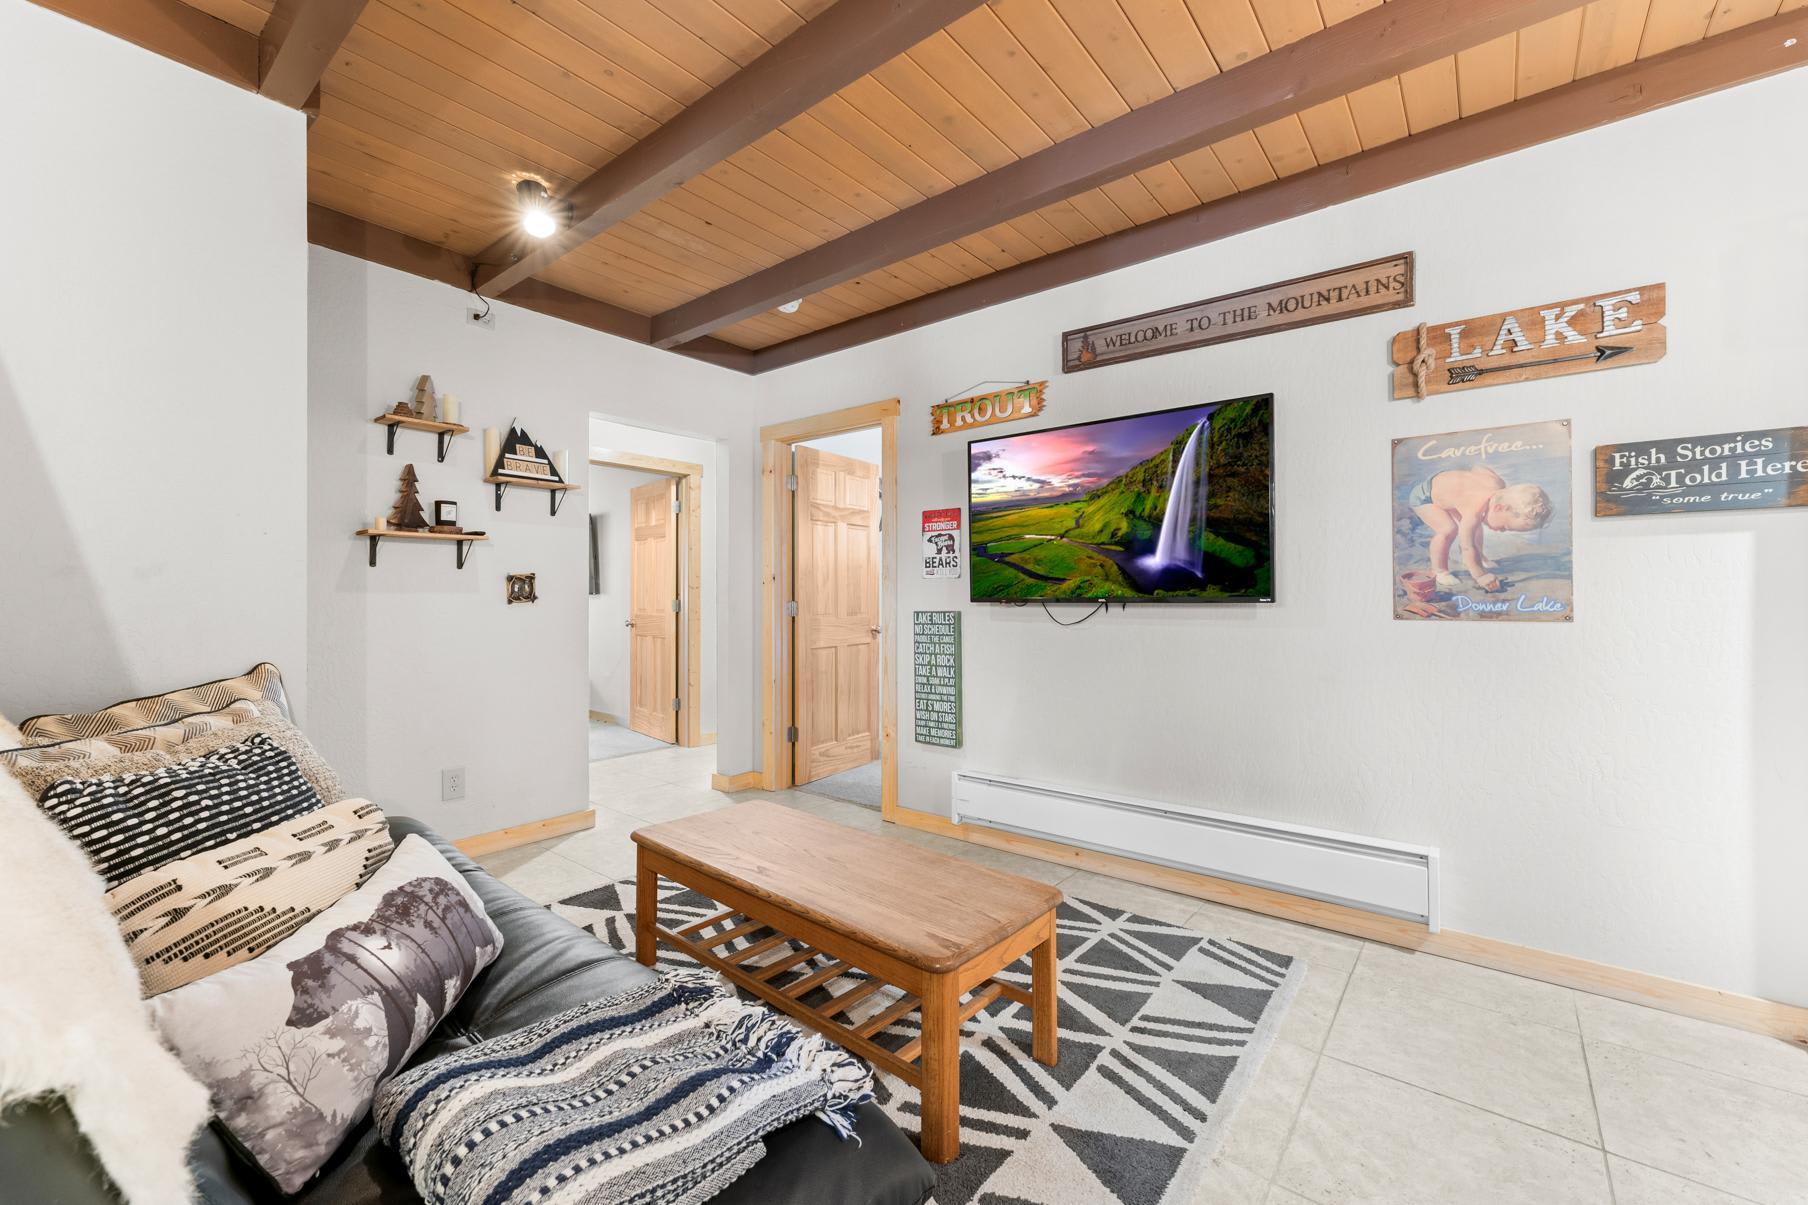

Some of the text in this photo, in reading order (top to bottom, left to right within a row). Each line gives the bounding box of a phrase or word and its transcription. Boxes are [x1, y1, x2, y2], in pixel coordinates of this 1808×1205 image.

[1104, 273, 1405, 350] WELCOME TO THE MOUNTAINS
[1444, 291, 1643, 363] LAKE
[936, 387, 1038, 429] TROUT
[518, 446, 534, 458] BE
[1612, 435, 1773, 470] Fish Stories
[506, 460, 548, 476] BRAVE
[1662, 463, 1728, 488] Told
[924, 521, 957, 531] STRONGER
[925, 556, 958, 569] BEARS
[1451, 593, 1565, 611] Donner Lake
[915, 612, 954, 624] LAKE RULES
[915, 624, 954, 635] NO SCHEDULE
[915, 643, 954, 655] CATCH A FISH
[915, 654, 955, 666] SKIP A ROCK
[915, 665, 955, 677] TAKE A WALK
[916, 684, 930, 692] RELAX
[936, 686, 955, 695] UNWIND
[916, 700, 955, 712] EAT S'MORES
[916, 710, 955, 723] WISH ON STARS
[916, 726, 955, 738] MAKE MEMORIES
